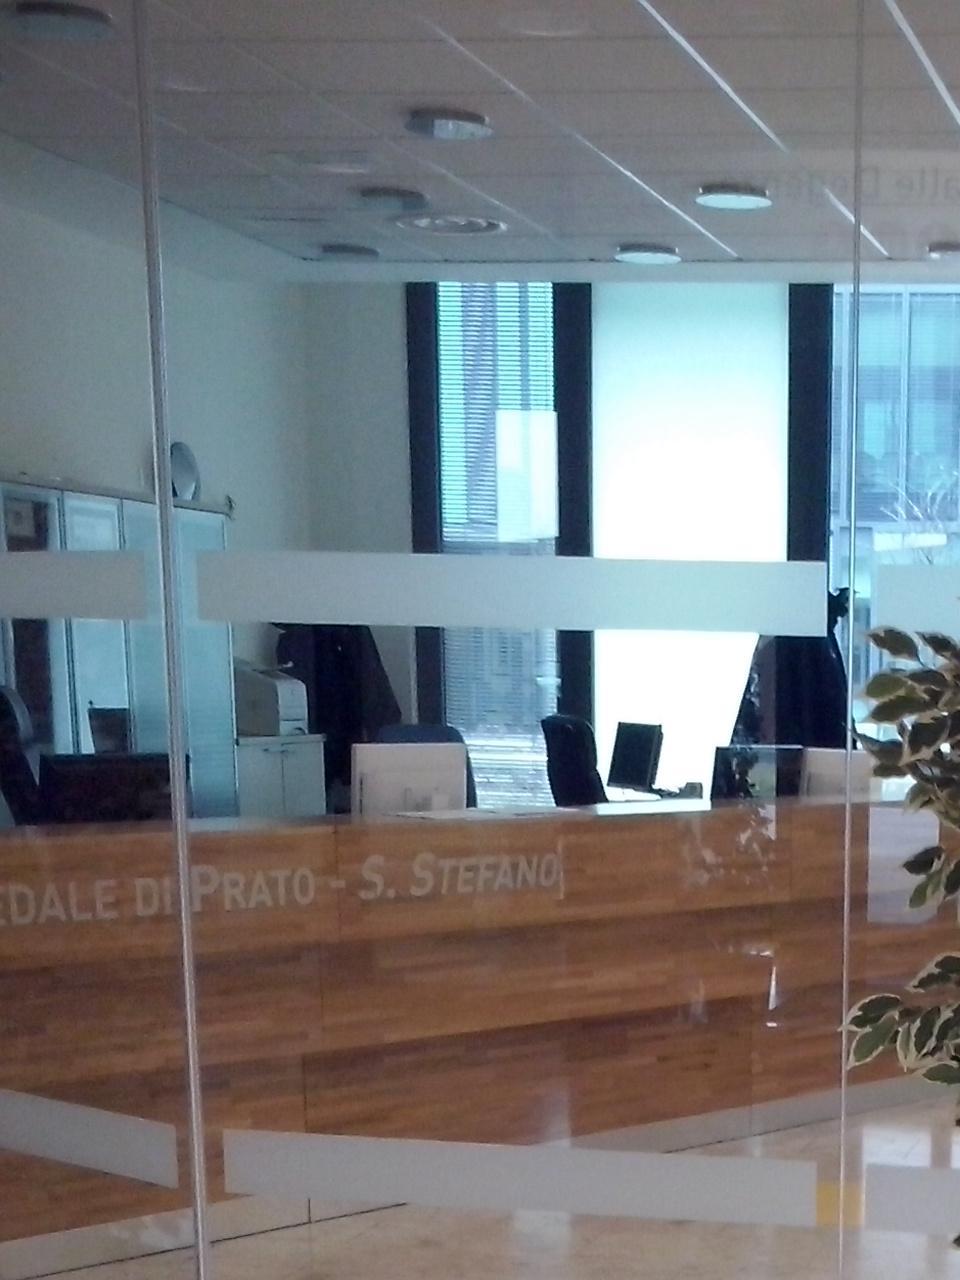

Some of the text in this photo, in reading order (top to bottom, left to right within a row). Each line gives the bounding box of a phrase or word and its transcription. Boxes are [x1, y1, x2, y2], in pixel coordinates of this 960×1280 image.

[134, 877, 173, 917] DI
[190, 864, 316, 913] PRATO
[409, 852, 562, 897] STEFANO
